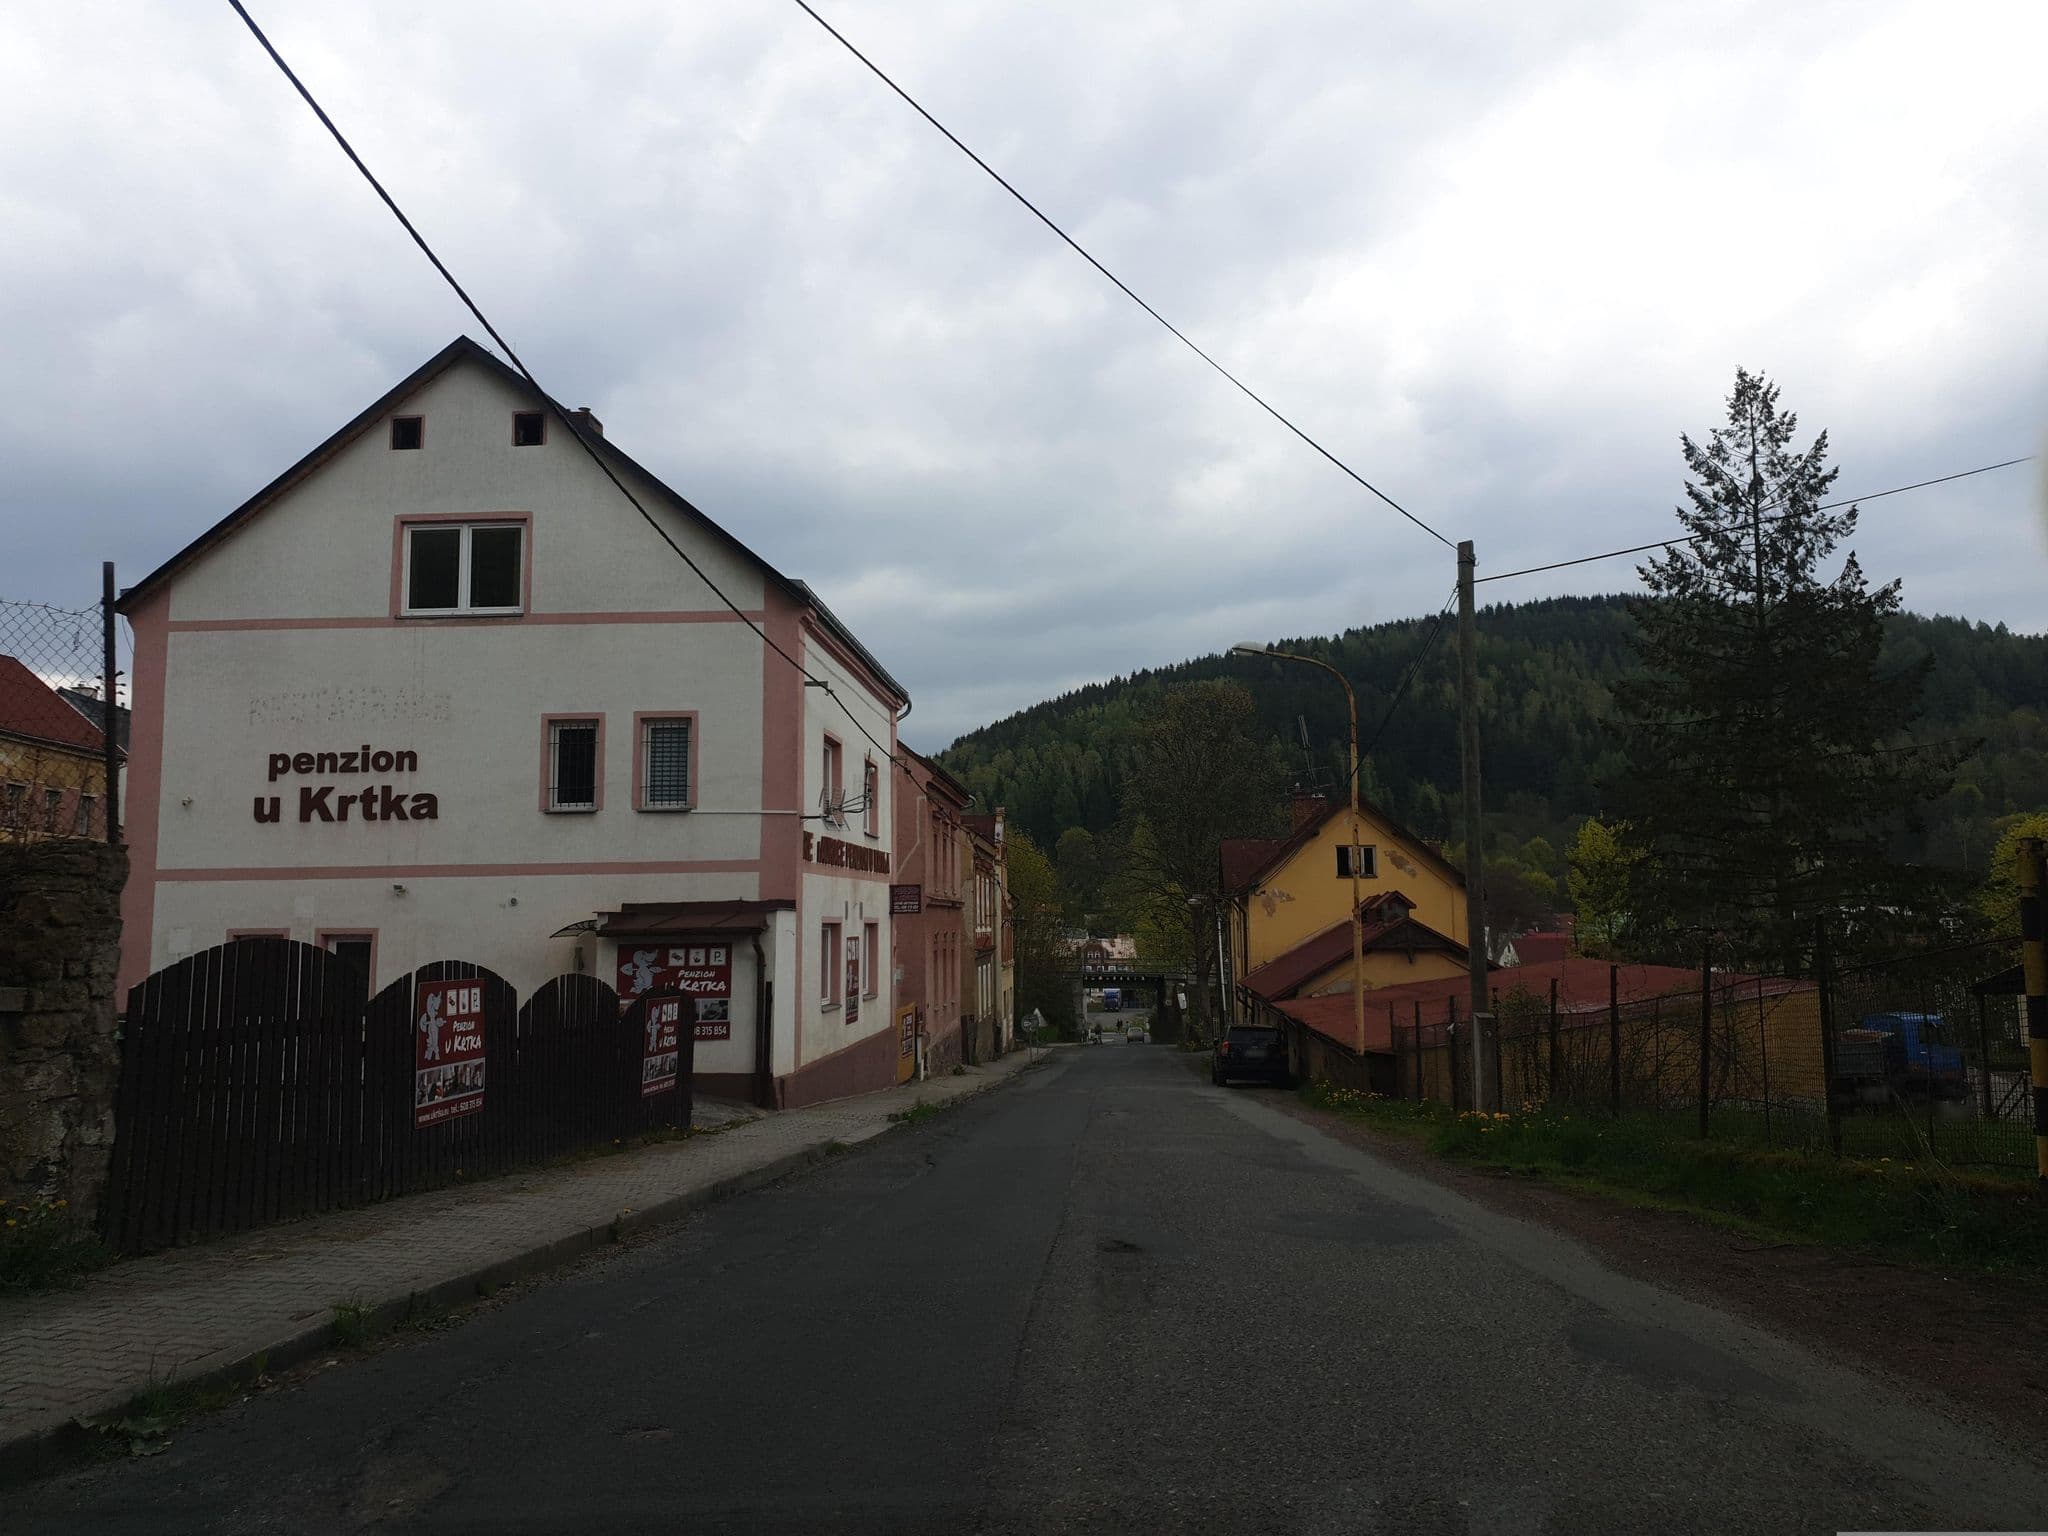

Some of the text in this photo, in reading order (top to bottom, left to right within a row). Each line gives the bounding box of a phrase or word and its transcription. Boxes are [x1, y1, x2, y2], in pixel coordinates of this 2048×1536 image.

[268, 744, 418, 782] penzion
[253, 785, 439, 824] u Krtka
[677, 969, 715, 979] PENZION
[678, 979, 727, 992] KRTKA
[701, 1025, 713, 1035] 315
[713, 1025, 727, 1035] 854
[453, 1034, 482, 1052] KRTKA
